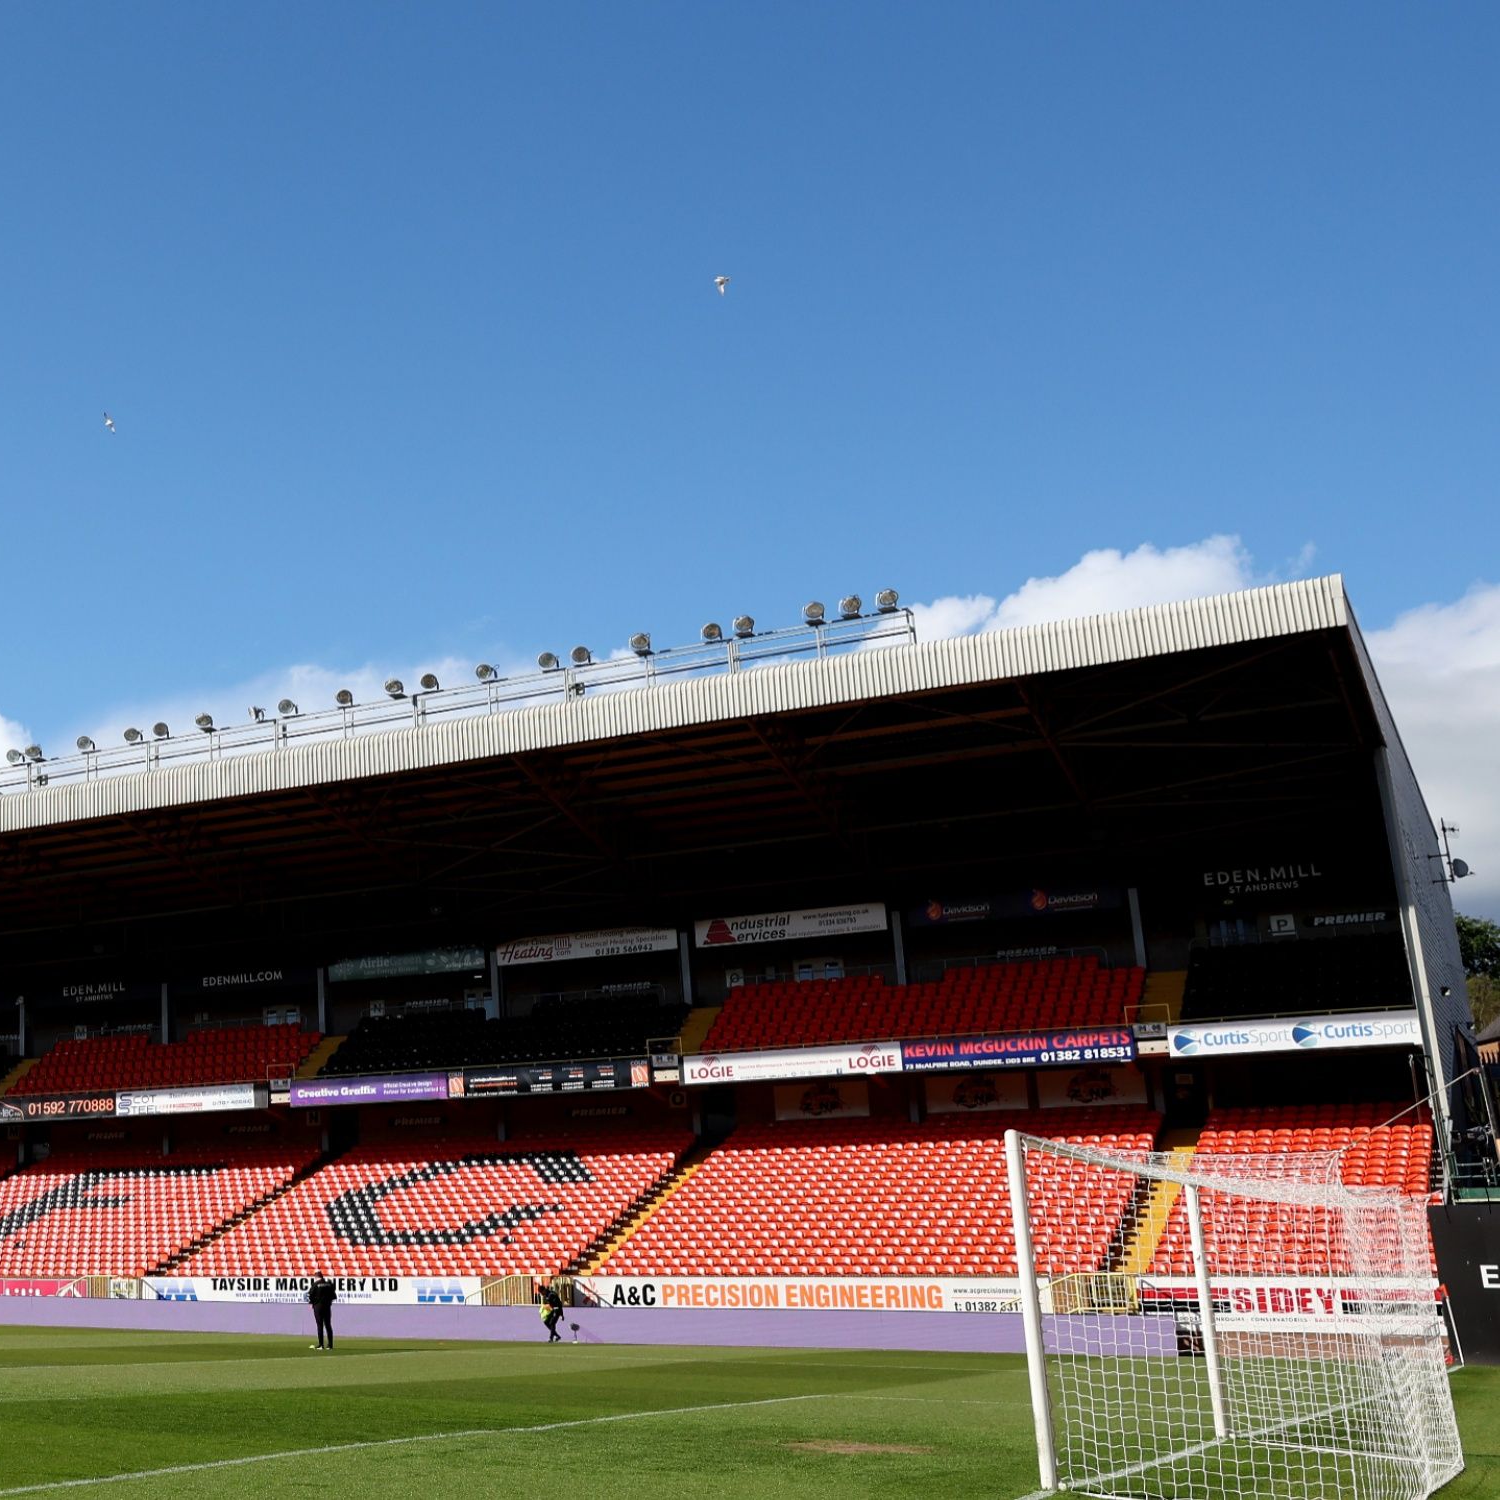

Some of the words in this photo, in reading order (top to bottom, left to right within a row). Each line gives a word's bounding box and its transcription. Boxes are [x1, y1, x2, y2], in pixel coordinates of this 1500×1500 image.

[1203, 863, 1322, 886] EDEN.MILL
[1229, 885, 1241, 894] ST
[1245, 879, 1300, 893] ANDREWS
[1047, 891, 1098, 905] Davidson
[943, 902, 990, 916] Davidson
[1313, 912, 1387, 926] PREMIER
[500, 943, 553, 962] Heating
[595, 948, 620, 956] 01382
[622, 943, 653, 953] 566942
[202, 970, 283, 987] EDENMILL.COM
[62, 982, 126, 997] EDEN.MILL
[84, 994, 114, 1003] ANDREWS
[904, 1041, 954, 1059] KEVIN
[959, 1036, 1048, 1055] McGUCKIN
[1051, 1030, 1131, 1050] CARPETS
[1203, 1028, 1290, 1048] CurtisSport
[848, 1054, 896, 1069] LOGIE
[1040, 1051, 1081, 1064] 01382
[1084, 1046, 1132, 1060] 818531
[689, 1065, 734, 1079] LOGIE
[297, 1087, 339, 1098] Creative
[340, 1085, 377, 1096] Graffix
[28, 1101, 66, 1116] 01592
[69, 1097, 115, 1113] 770888
[571, 1106, 627, 1117] PREMIER
[228, 1124, 271, 1134] PRIME
[393, 1116, 442, 1127] PREMIER
[87, 1131, 126, 1140] PRIME
[211, 1277, 273, 1291] TAYSIDE
[372, 1277, 399, 1292] LTD
[612, 1284, 656, 1306] A&C
[661, 1284, 778, 1307] PRECISION
[785, 1284, 944, 1309] ENGINEERING
[1231, 1287, 1337, 1314] SIDEY
[954, 1301, 963, 1312] t:
[965, 1301, 997, 1312] 01382
